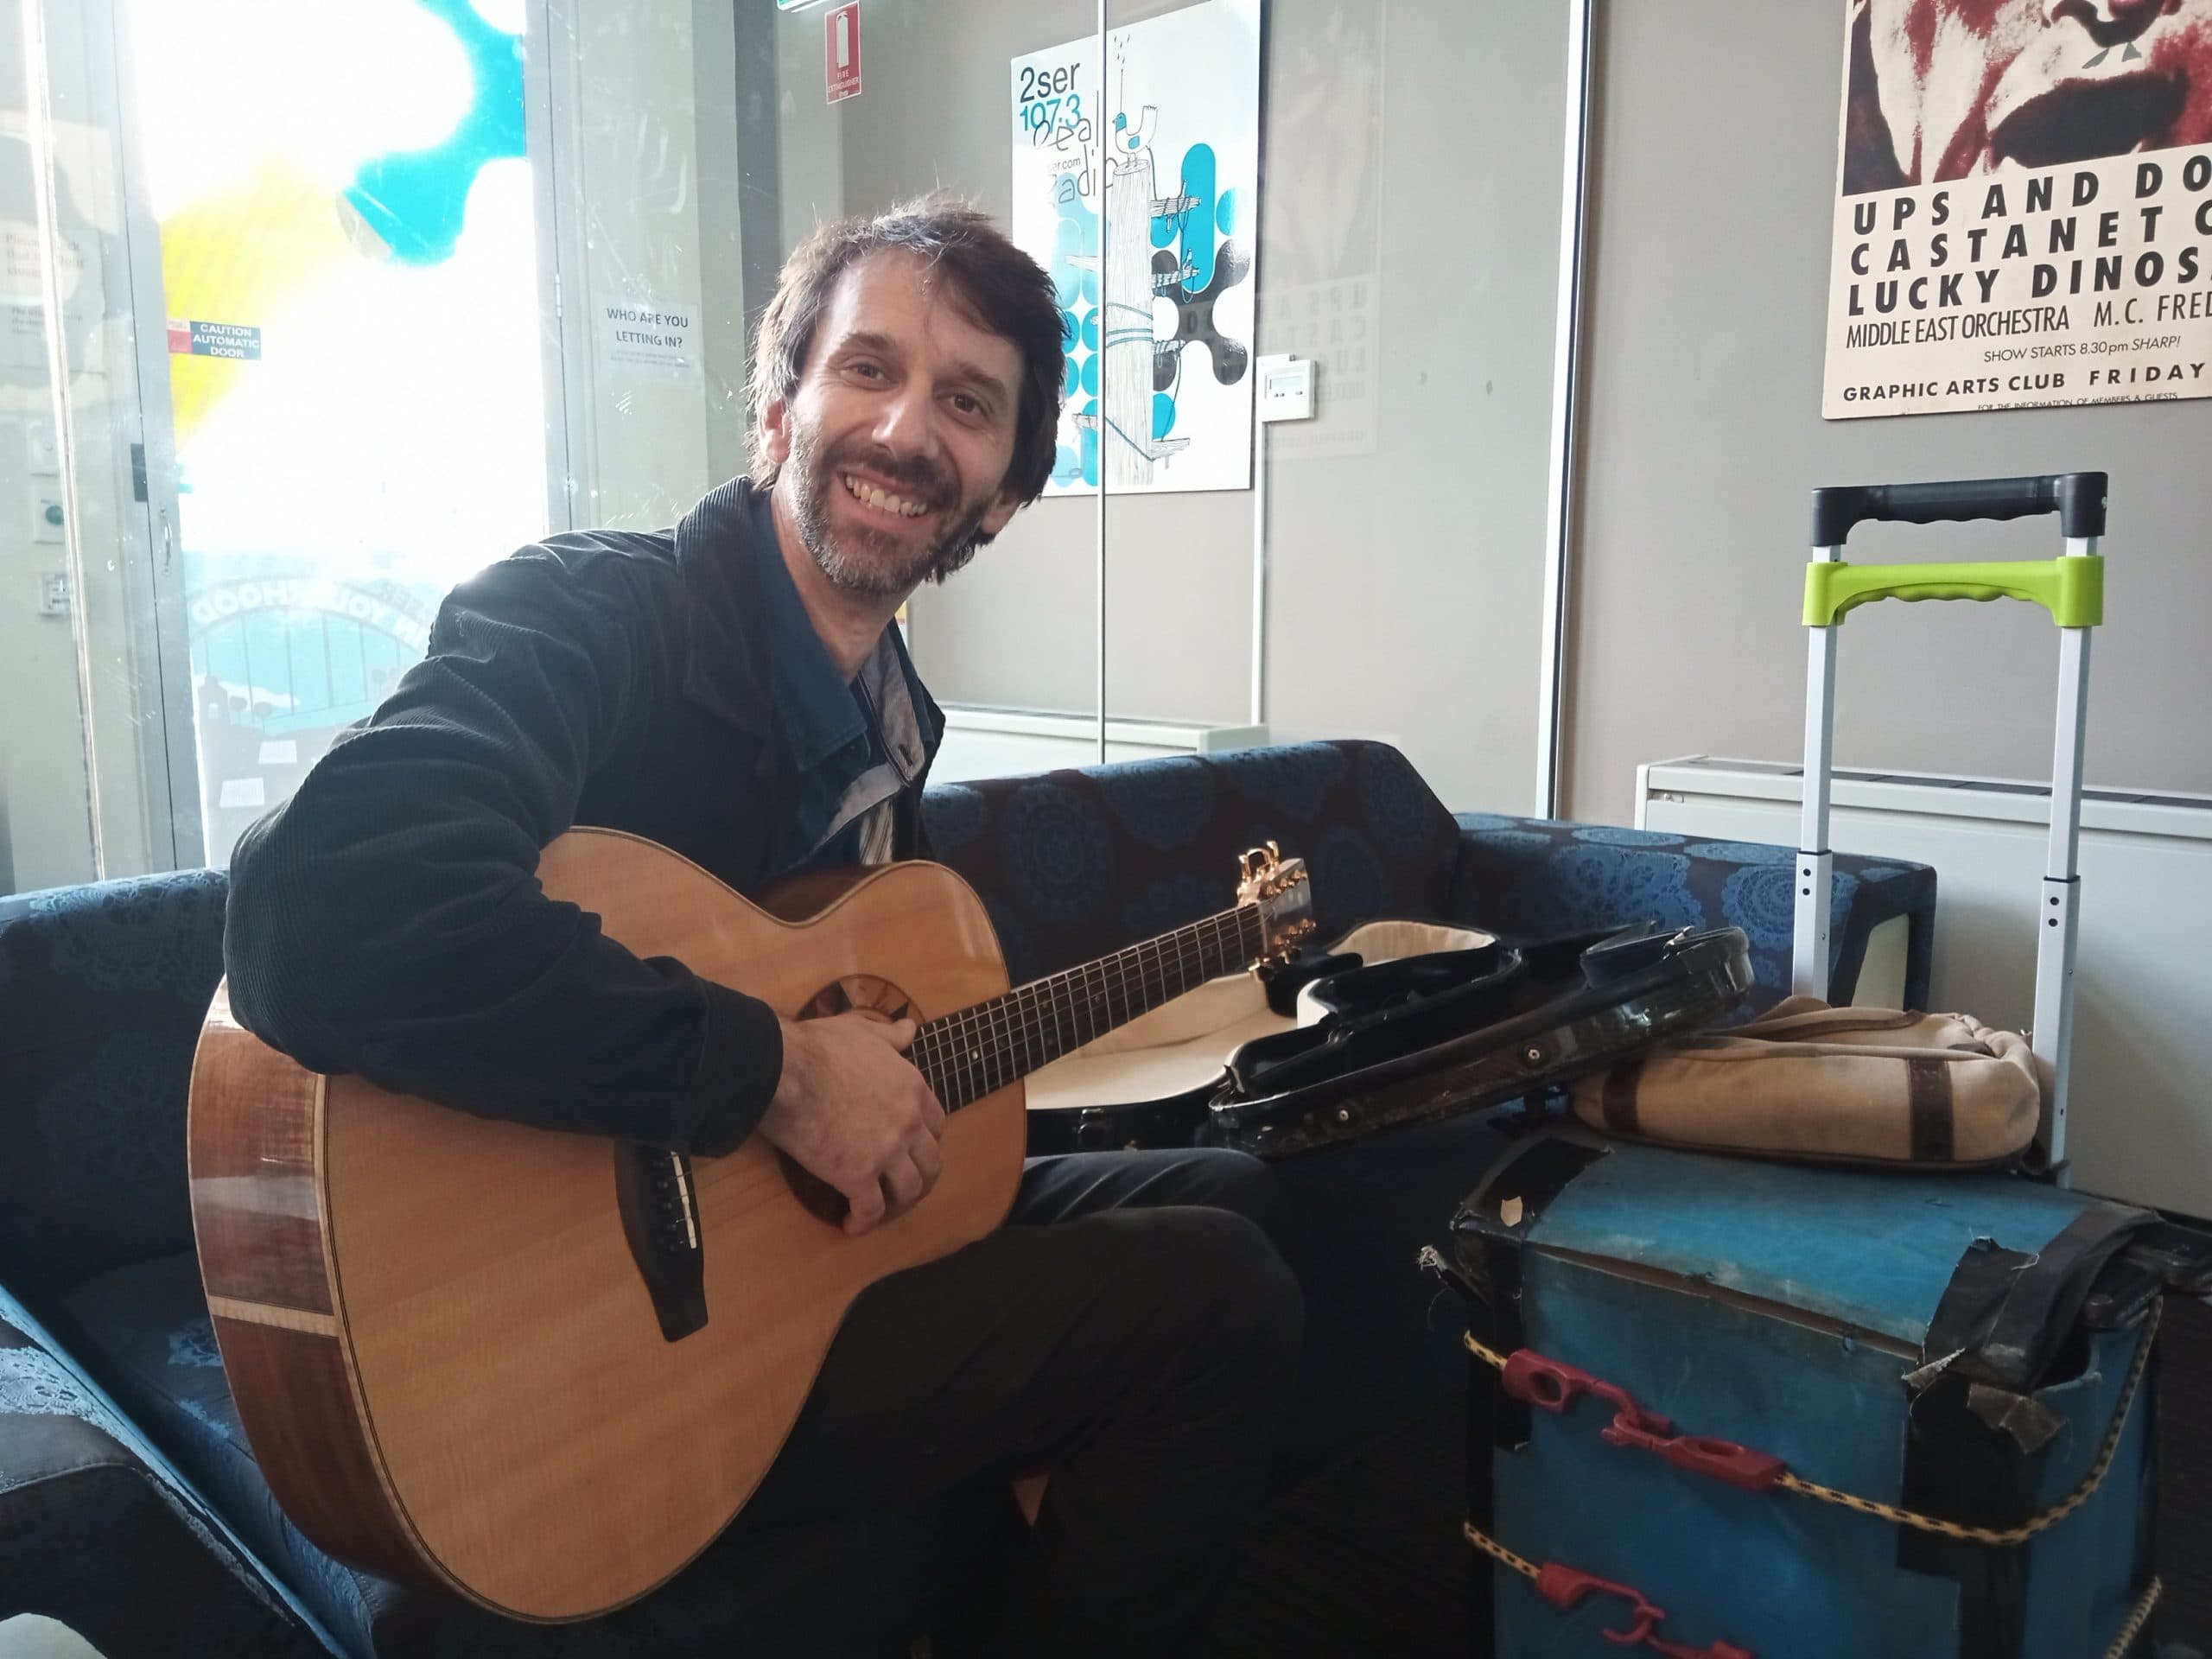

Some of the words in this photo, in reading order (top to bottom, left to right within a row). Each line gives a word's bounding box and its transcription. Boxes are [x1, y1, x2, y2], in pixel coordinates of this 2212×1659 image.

[1020, 62, 1080, 103] 2ser
[1020, 93, 1081, 133] 107.3
[1853, 191, 1949, 236] UPS
[1981, 171, 2100, 219] AND
[2135, 155, 2212, 199] DO
[1851, 206, 2163, 276] CASTANET
[1848, 268, 2000, 316] LUCKY
[2031, 246, 2212, 298] DINOS
[200, 323, 251, 338] CAUTION
[607, 308, 637, 321] WHO
[639, 312, 662, 324] ARE
[664, 315, 689, 327] YOU
[1846, 319, 1910, 348] MIDDLE
[1914, 315, 1956, 342] EAST
[1961, 304, 2069, 339] ORCHESTRA
[2094, 298, 2144, 327] M.C.
[193, 334, 260, 348] AUTOMATIC
[210, 346, 245, 359] DOOR
[616, 331, 662, 346] LETTING
[664, 335, 683, 348] IN?
[1984, 349, 2026, 363] SHOW
[2031, 344, 2076, 359] STARTS
[2132, 335, 2181, 351] SHARP!
[1843, 382, 1938, 402] GRAPHIC
[1946, 377, 1999, 395] ARTS
[2008, 373, 2066, 391] CLUB
[2089, 363, 2205, 386] FRIDAY
[2014, 398, 2073, 409] INFORMATION
[2145, 391, 2178, 401] GUESTS
